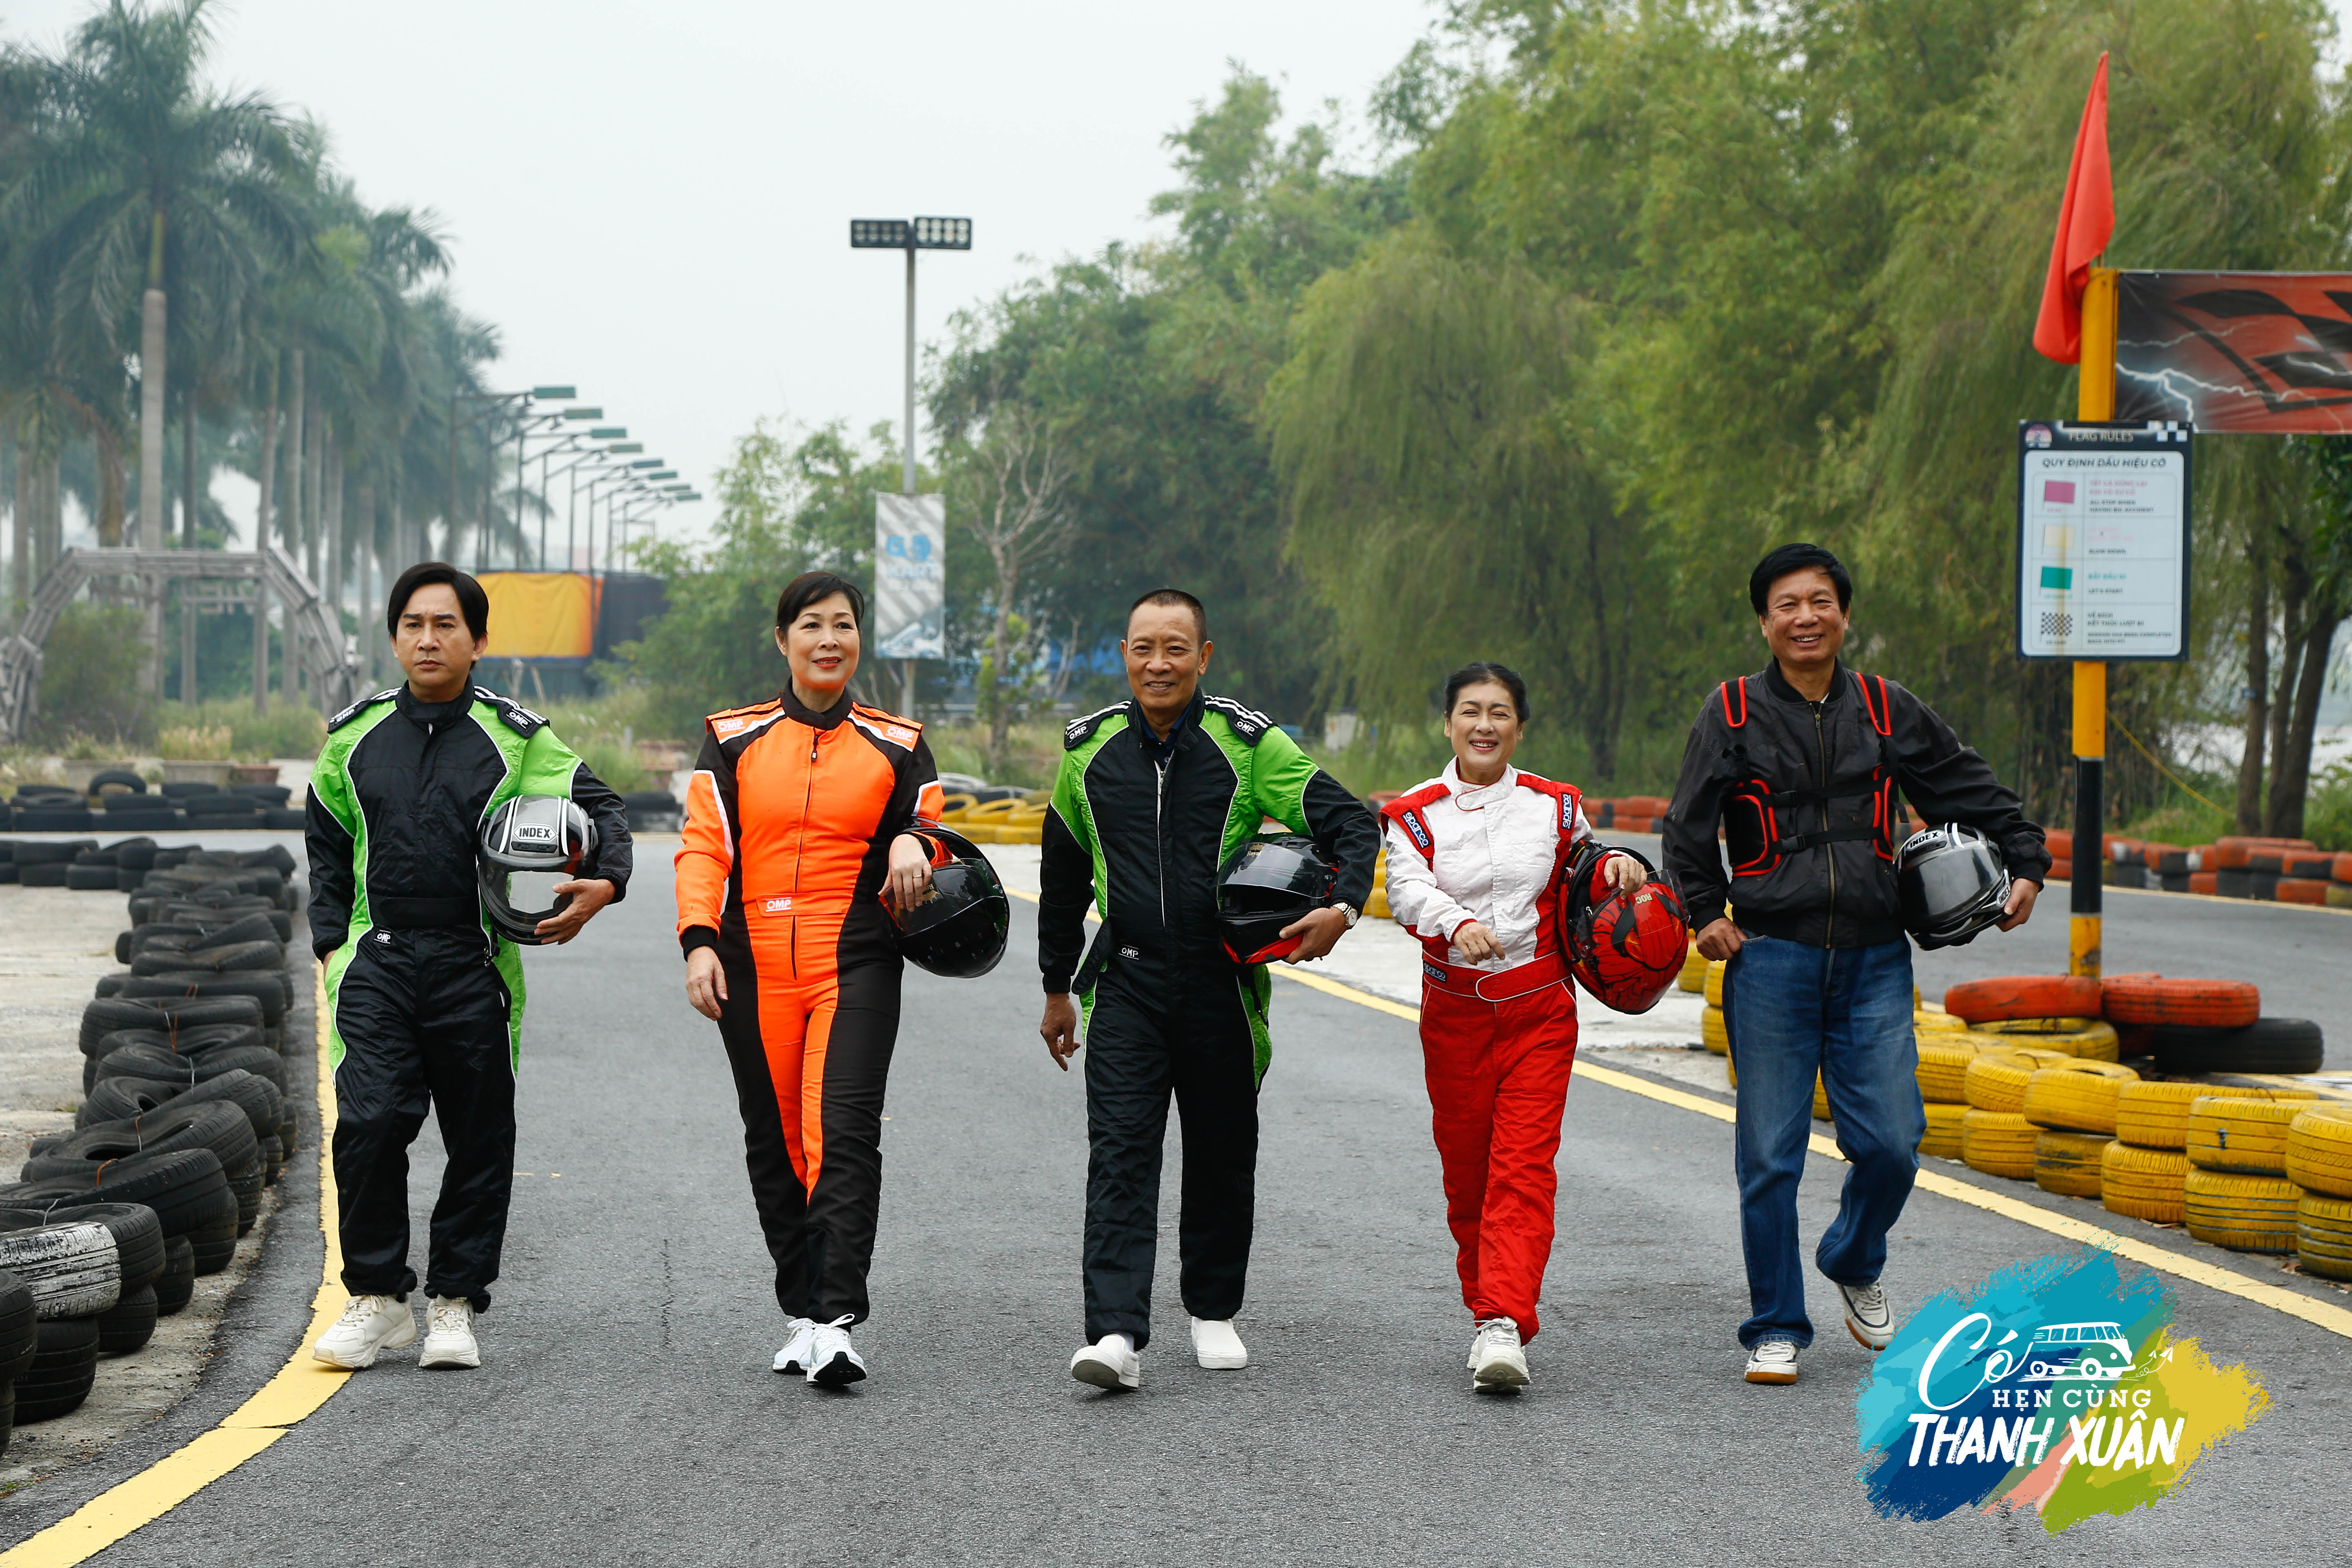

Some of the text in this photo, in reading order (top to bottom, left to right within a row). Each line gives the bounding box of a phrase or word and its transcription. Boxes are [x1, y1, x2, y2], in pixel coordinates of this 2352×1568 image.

[2069, 430, 2134, 442] FLAG RULES
[2042, 457, 2065, 468] QUY
[509, 711, 529, 726] OMP
[717, 721, 743, 730] OMP
[1236, 721, 1255, 733] OMP
[887, 728, 913, 739] OMP
[1069, 726, 1087, 739] OMP
[1562, 793, 1572, 827] sparco
[519, 828, 550, 838] INDEX
[1404, 811, 1429, 846] sparco
[1910, 831, 1939, 848] INDEX
[766, 899, 791, 909] OMP
[1635, 893, 1653, 904] ROC
[376, 933, 391, 942] OMP
[1121, 947, 1138, 958] OMP
[1424, 962, 1446, 979] sparco
